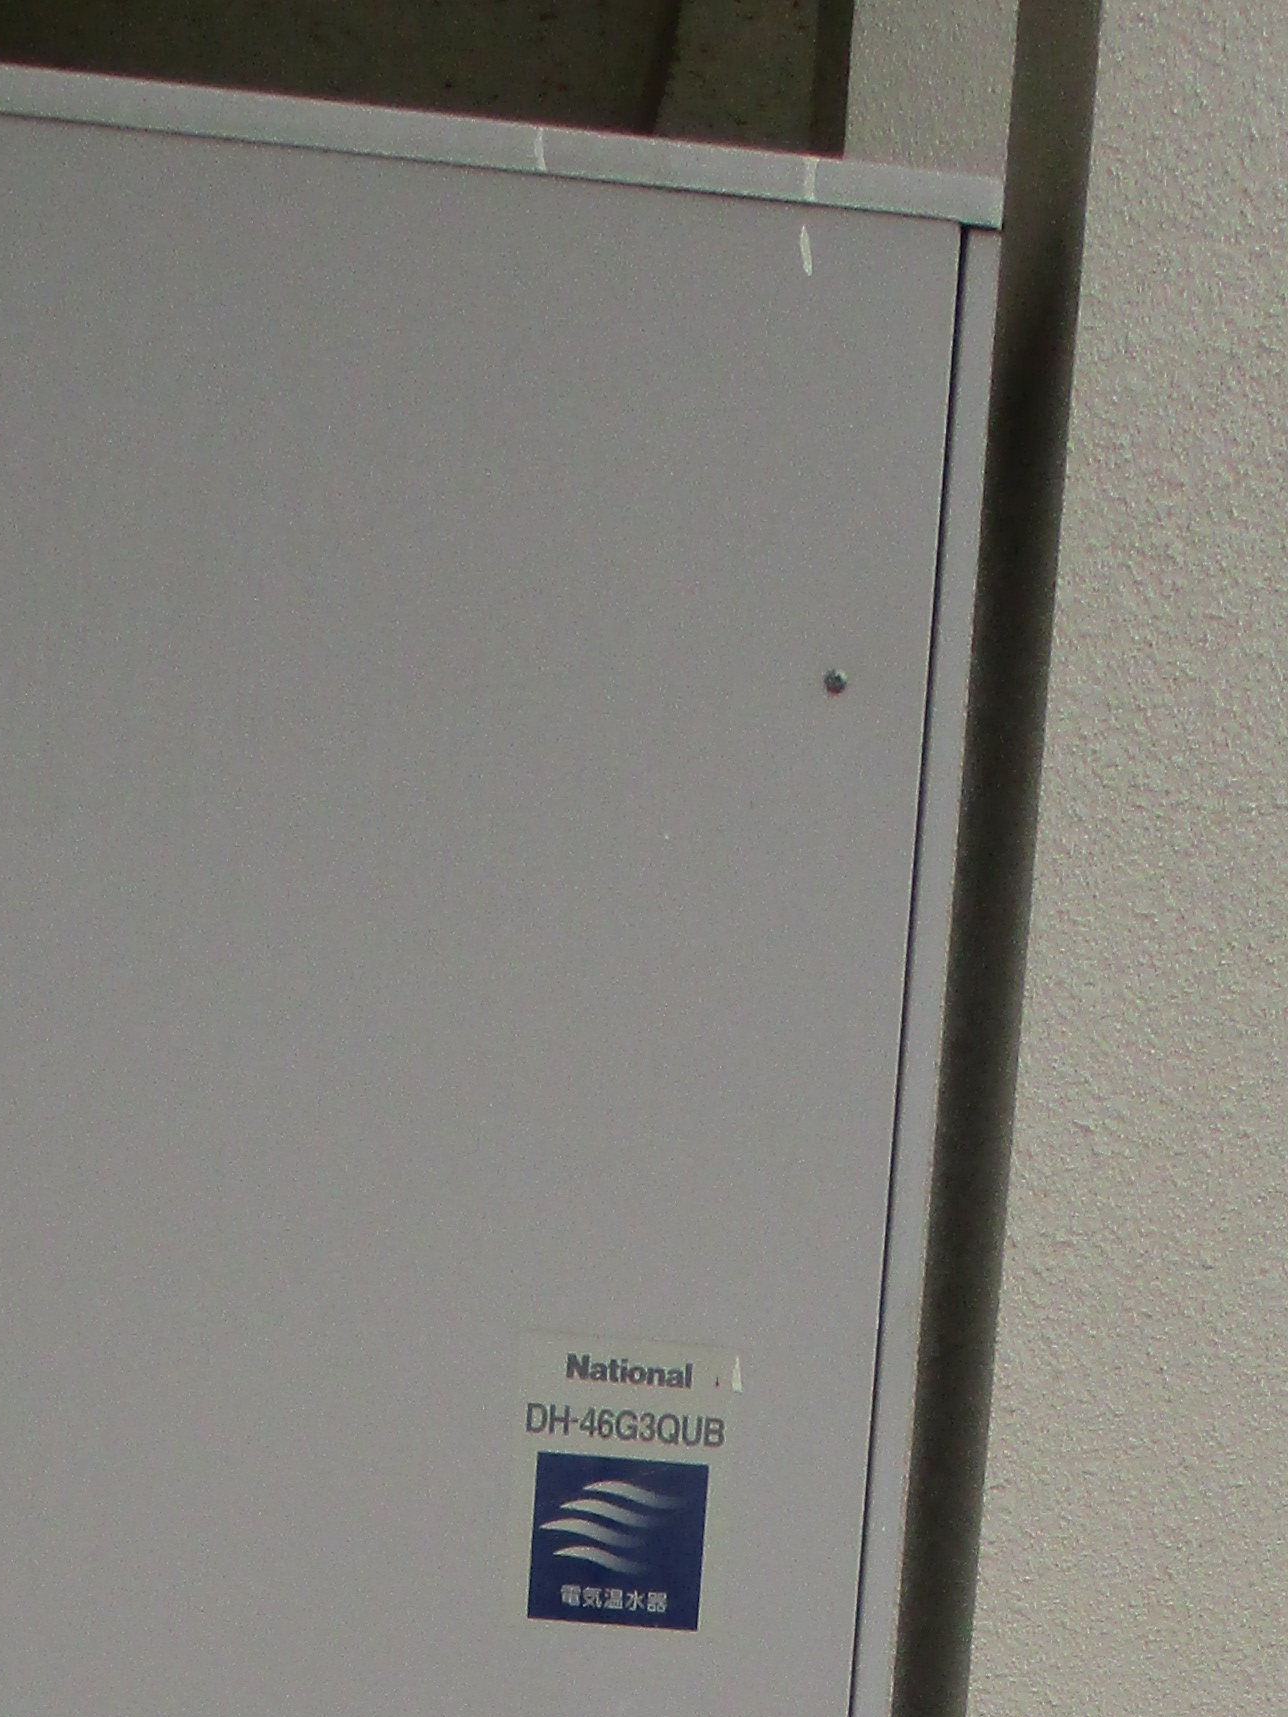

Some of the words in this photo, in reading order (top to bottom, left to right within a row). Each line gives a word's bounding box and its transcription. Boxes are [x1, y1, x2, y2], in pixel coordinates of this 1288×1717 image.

[566, 1352, 693, 1389] National
[524, 1402, 726, 1448] DH-46G3QUB
[559, 1584, 668, 1613] 電気温水器
